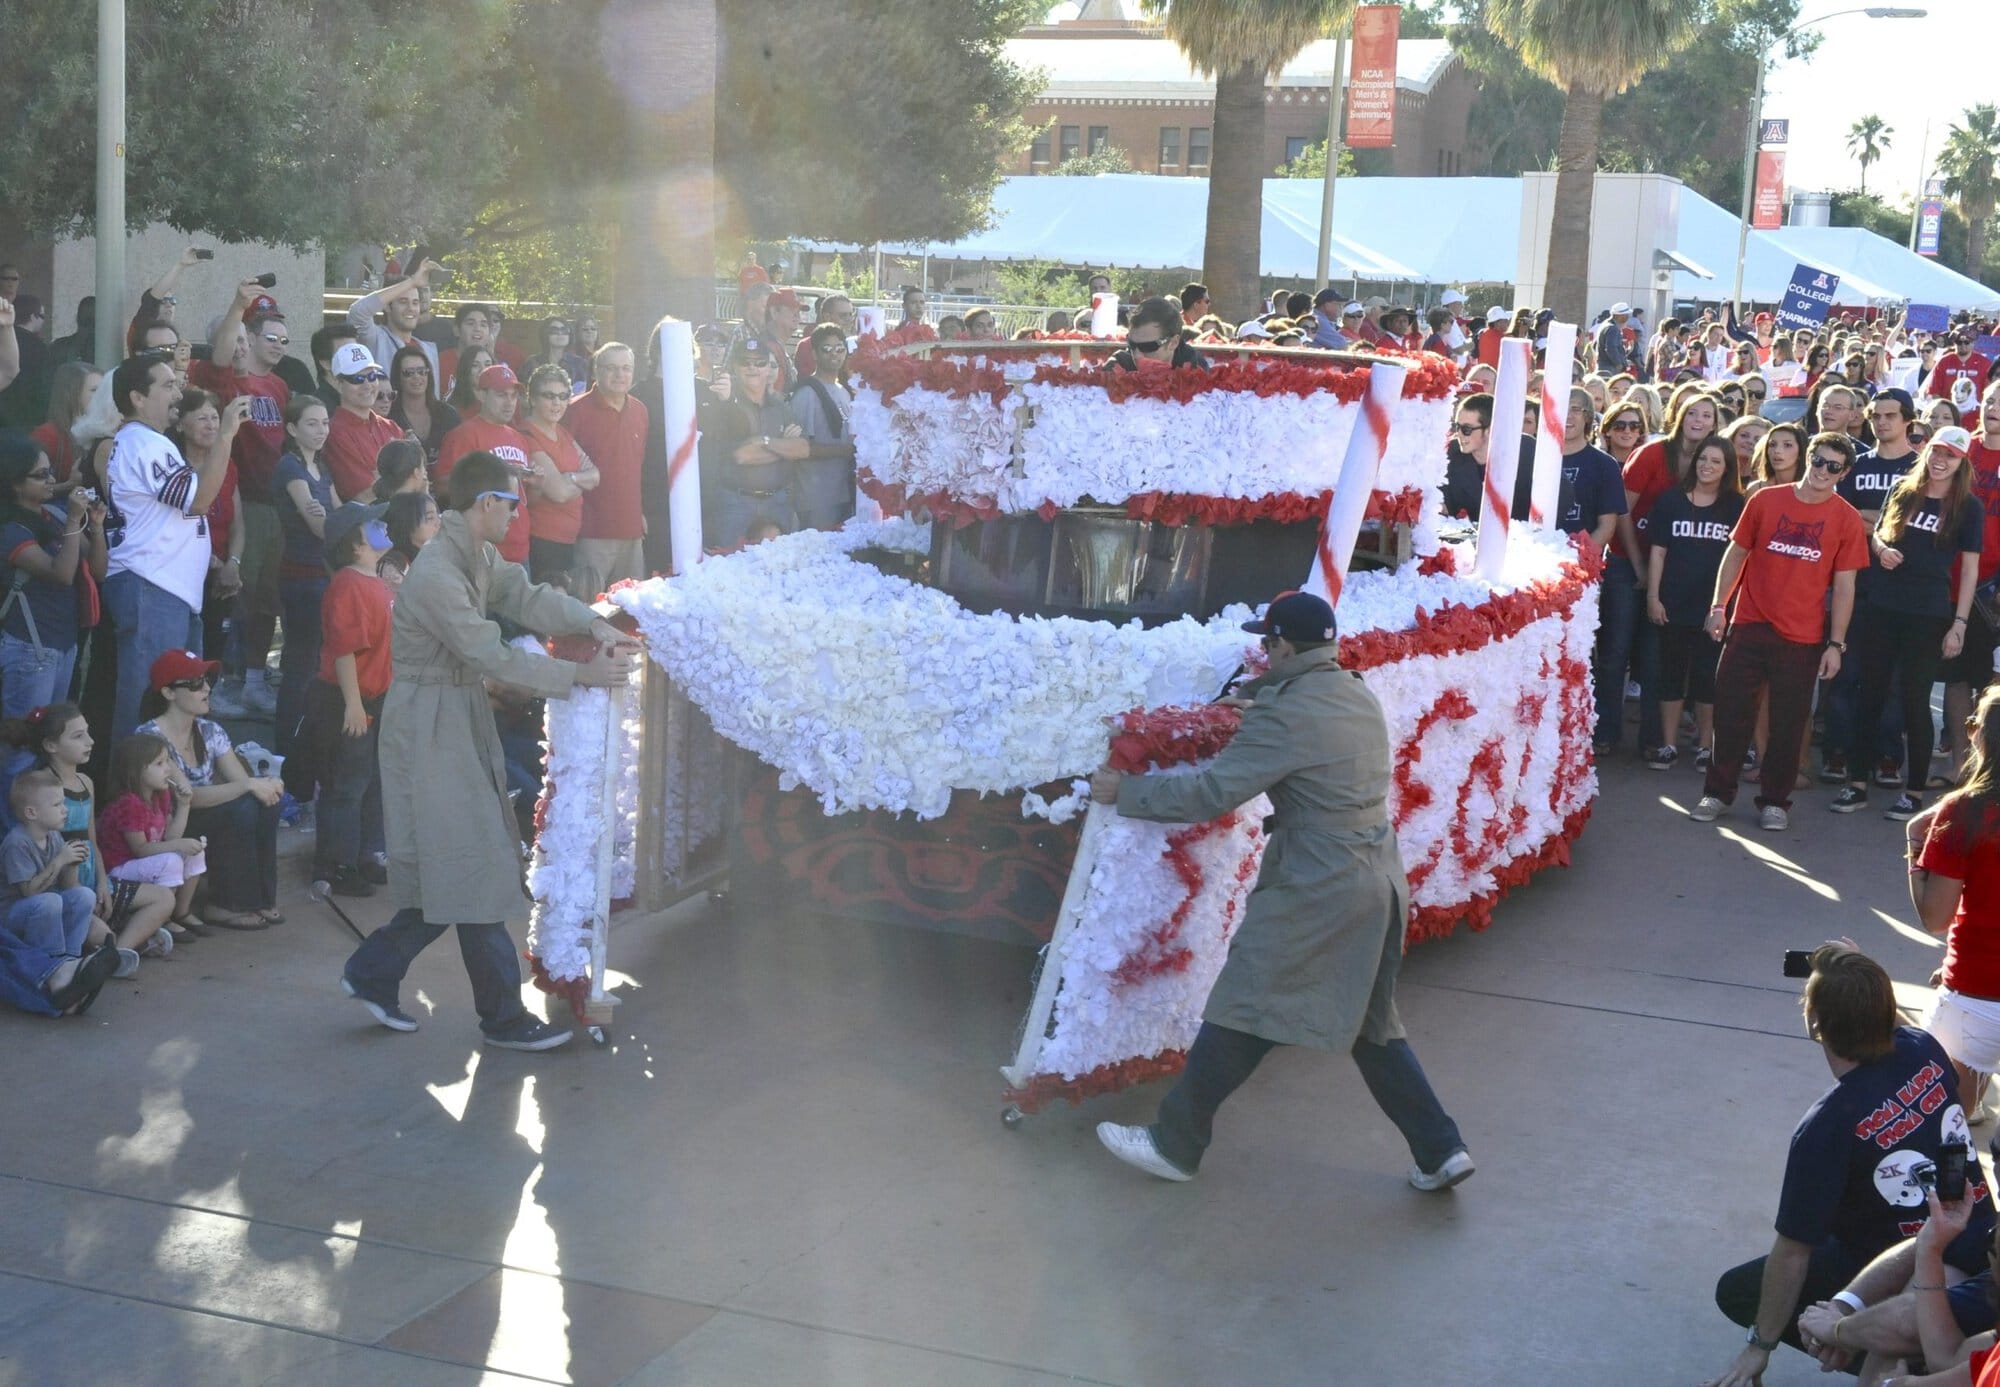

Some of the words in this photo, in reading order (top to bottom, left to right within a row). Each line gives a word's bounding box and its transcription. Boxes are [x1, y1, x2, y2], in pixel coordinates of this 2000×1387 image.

[1361, 69, 1383, 78] NCAA
[1350, 80, 1394, 90] Champions
[1355, 89, 1379, 98] Men's
[1380, 90, 1388, 99] &
[1353, 100, 1389, 109] Women's
[1350, 110, 1392, 120] Swimming
[1789, 283, 1833, 304] COLLEGE
[1797, 300, 1812, 311] OF
[1775, 309, 1823, 329] PHARMACY
[151, 452, 181, 483] 44
[1855, 473, 1908, 491] COLLE
[1672, 519, 1730, 542] COLLEGE
